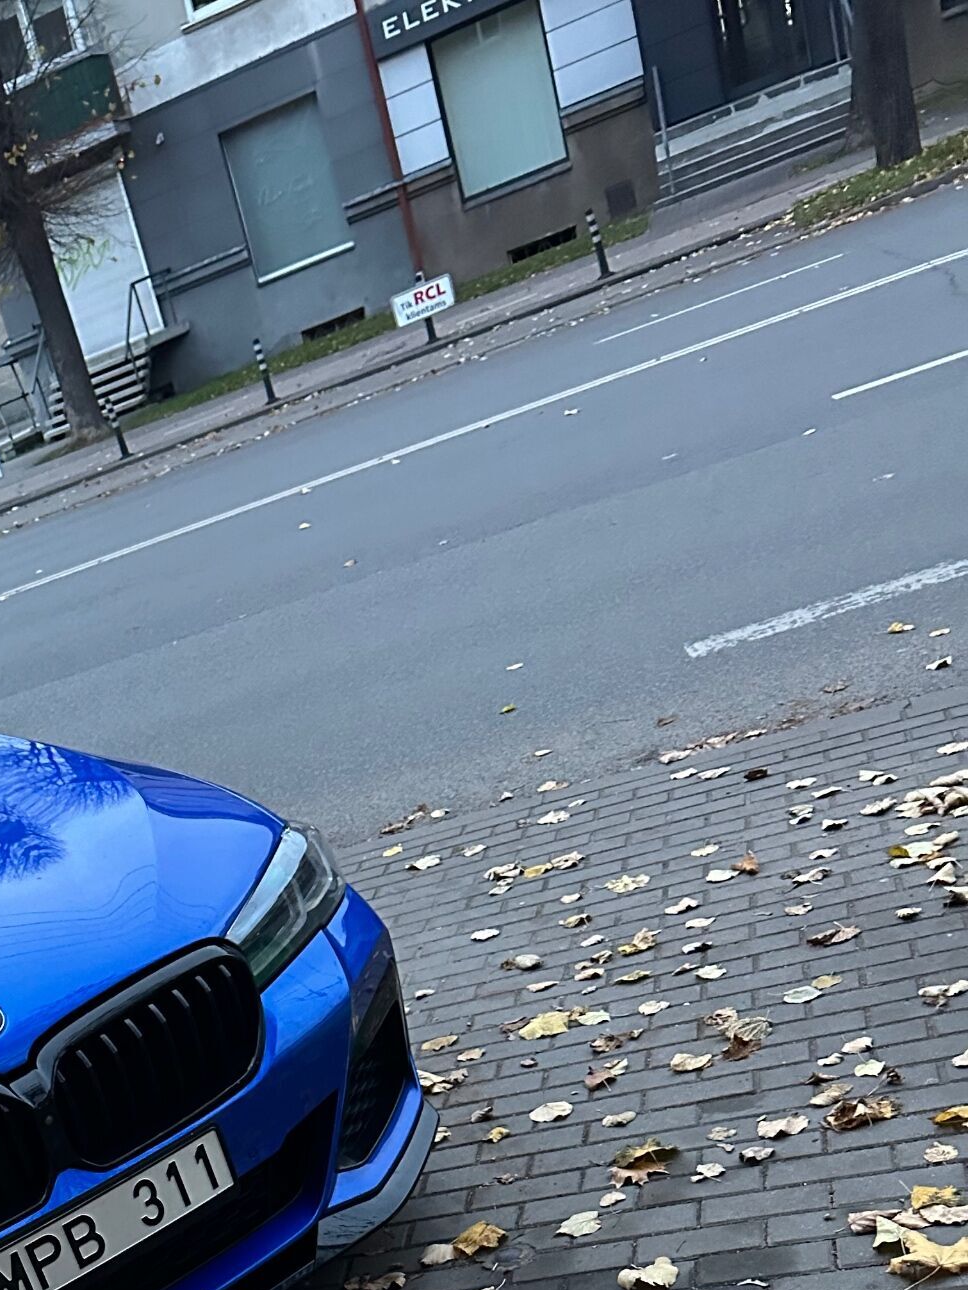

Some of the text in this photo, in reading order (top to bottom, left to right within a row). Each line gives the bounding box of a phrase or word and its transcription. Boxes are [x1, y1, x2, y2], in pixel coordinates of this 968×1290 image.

[382, 0, 473, 40] ELEK
[413, 283, 447, 306] RCL
[406, 300, 447, 321] klientams
[132, 1143, 220, 1227] 311
